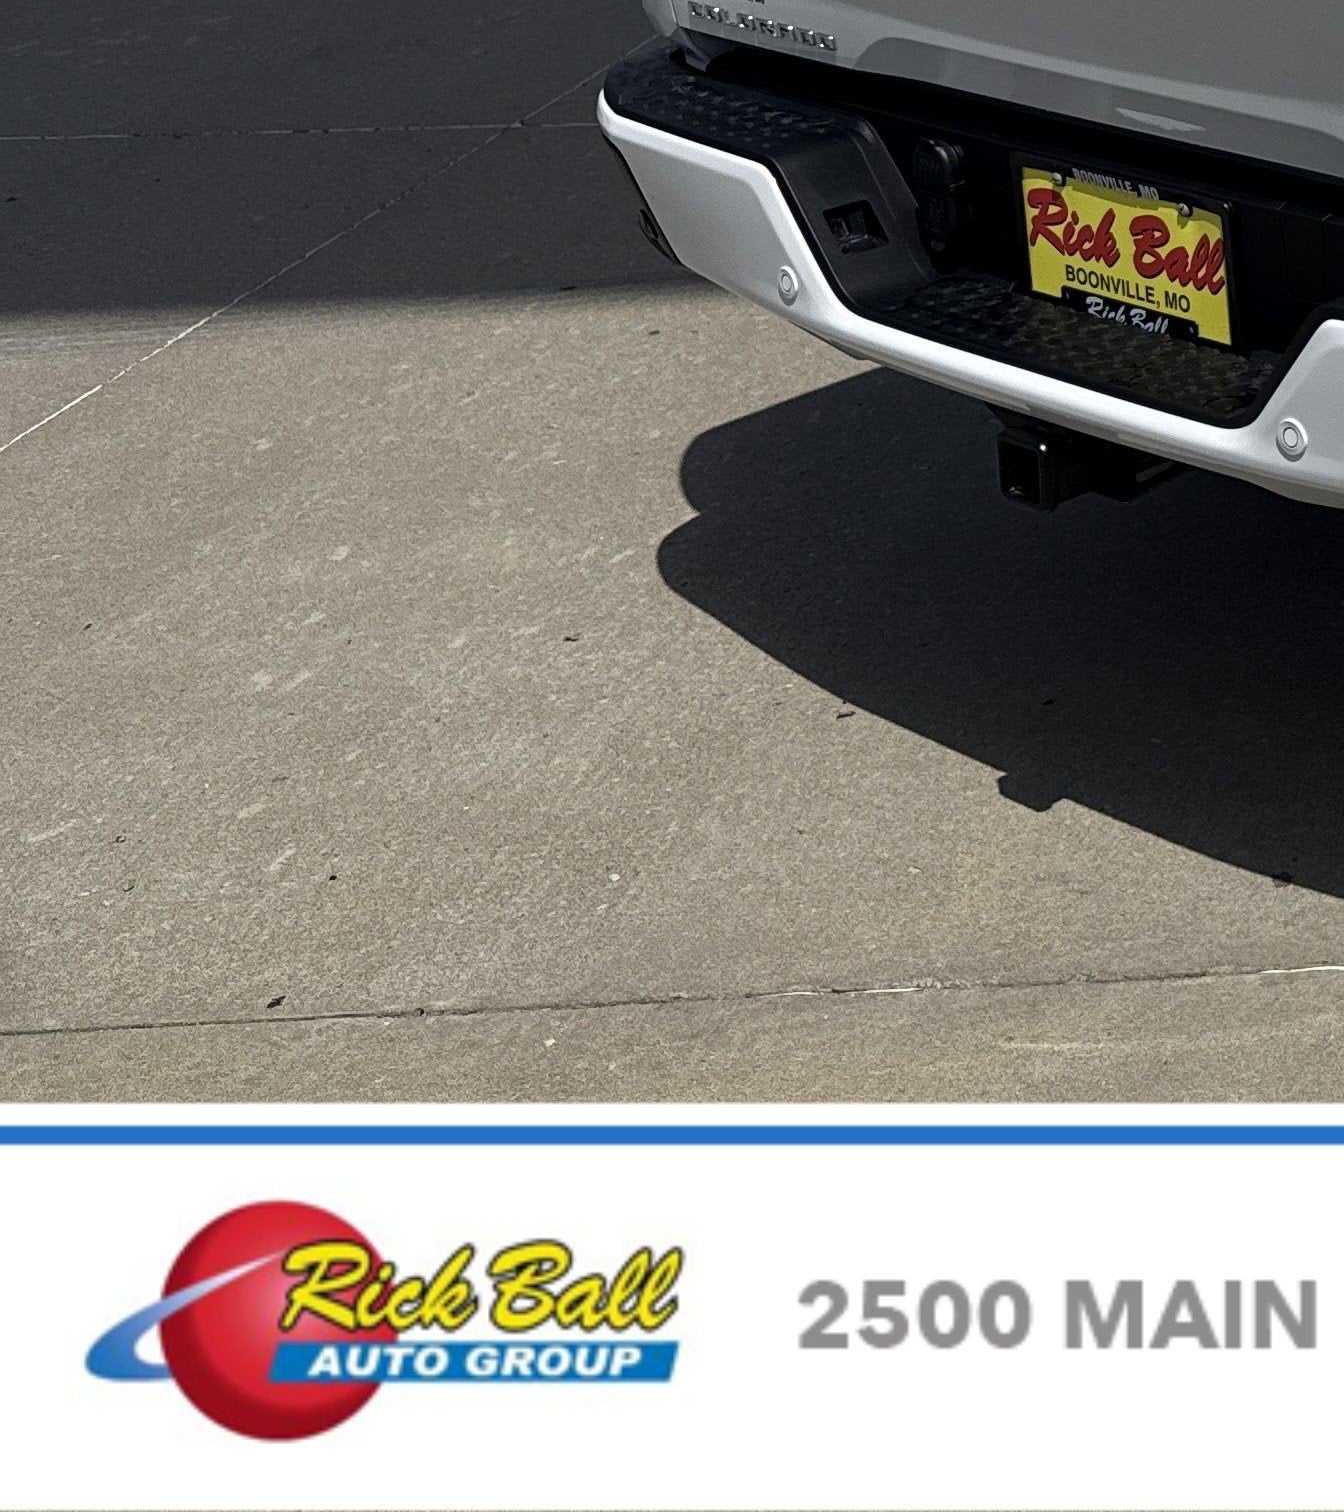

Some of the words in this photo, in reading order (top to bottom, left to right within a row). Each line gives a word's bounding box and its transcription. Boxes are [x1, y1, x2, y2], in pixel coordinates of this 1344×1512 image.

[1071, 167, 1138, 194] BOONVILLE,
[1139, 183, 1159, 201] MO
[1027, 187, 1121, 268] Rick
[1129, 214, 1226, 295] Ball
[1065, 264, 1162, 309] BOONVILLE,
[1164, 290, 1191, 313] MO
